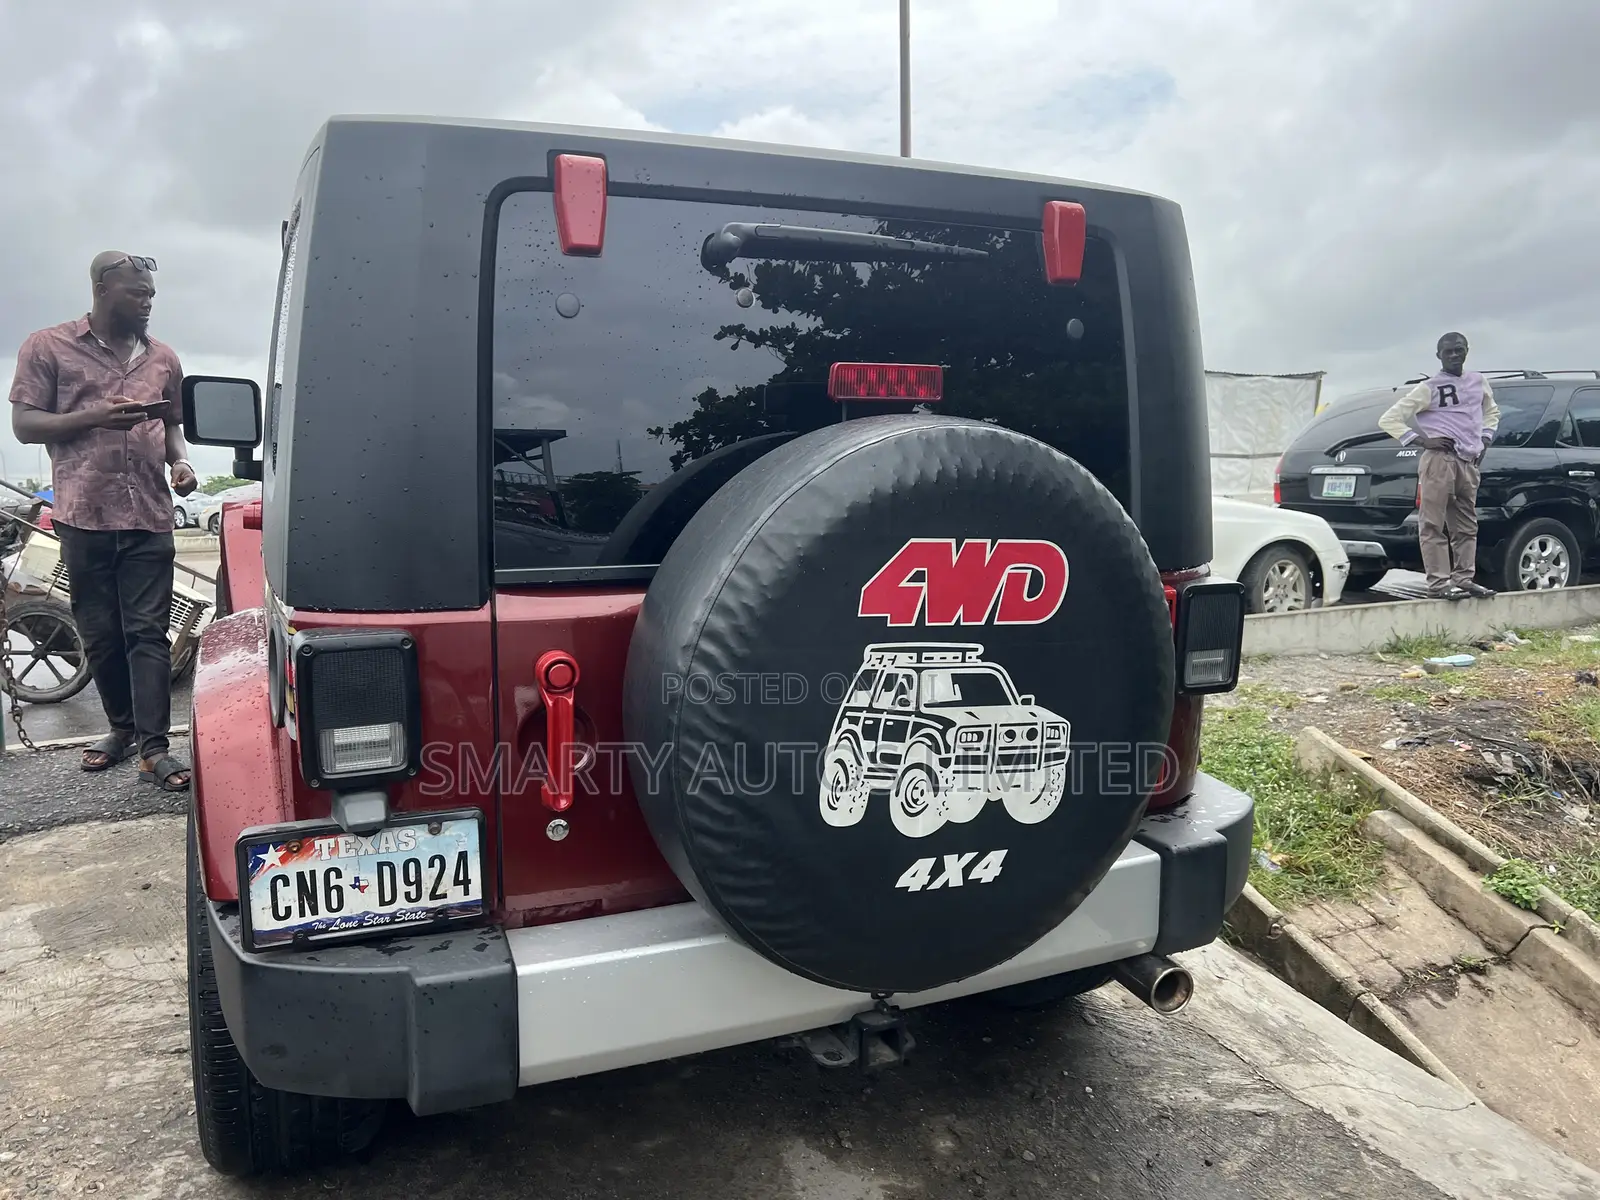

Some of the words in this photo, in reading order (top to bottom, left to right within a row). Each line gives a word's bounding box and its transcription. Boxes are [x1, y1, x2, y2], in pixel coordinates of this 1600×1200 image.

[1436, 383, 1460, 408] R
[857, 537, 1070, 627] 4WD
[314, 828, 417, 861] TEXAS
[269, 866, 345, 922] CN6
[376, 850, 472, 908] D924
[894, 848, 1009, 893] 4X4
[312, 921, 327, 931] The
[328, 914, 359, 931] Lone
[362, 913, 392, 926] Star
[394, 910, 427, 923] State
